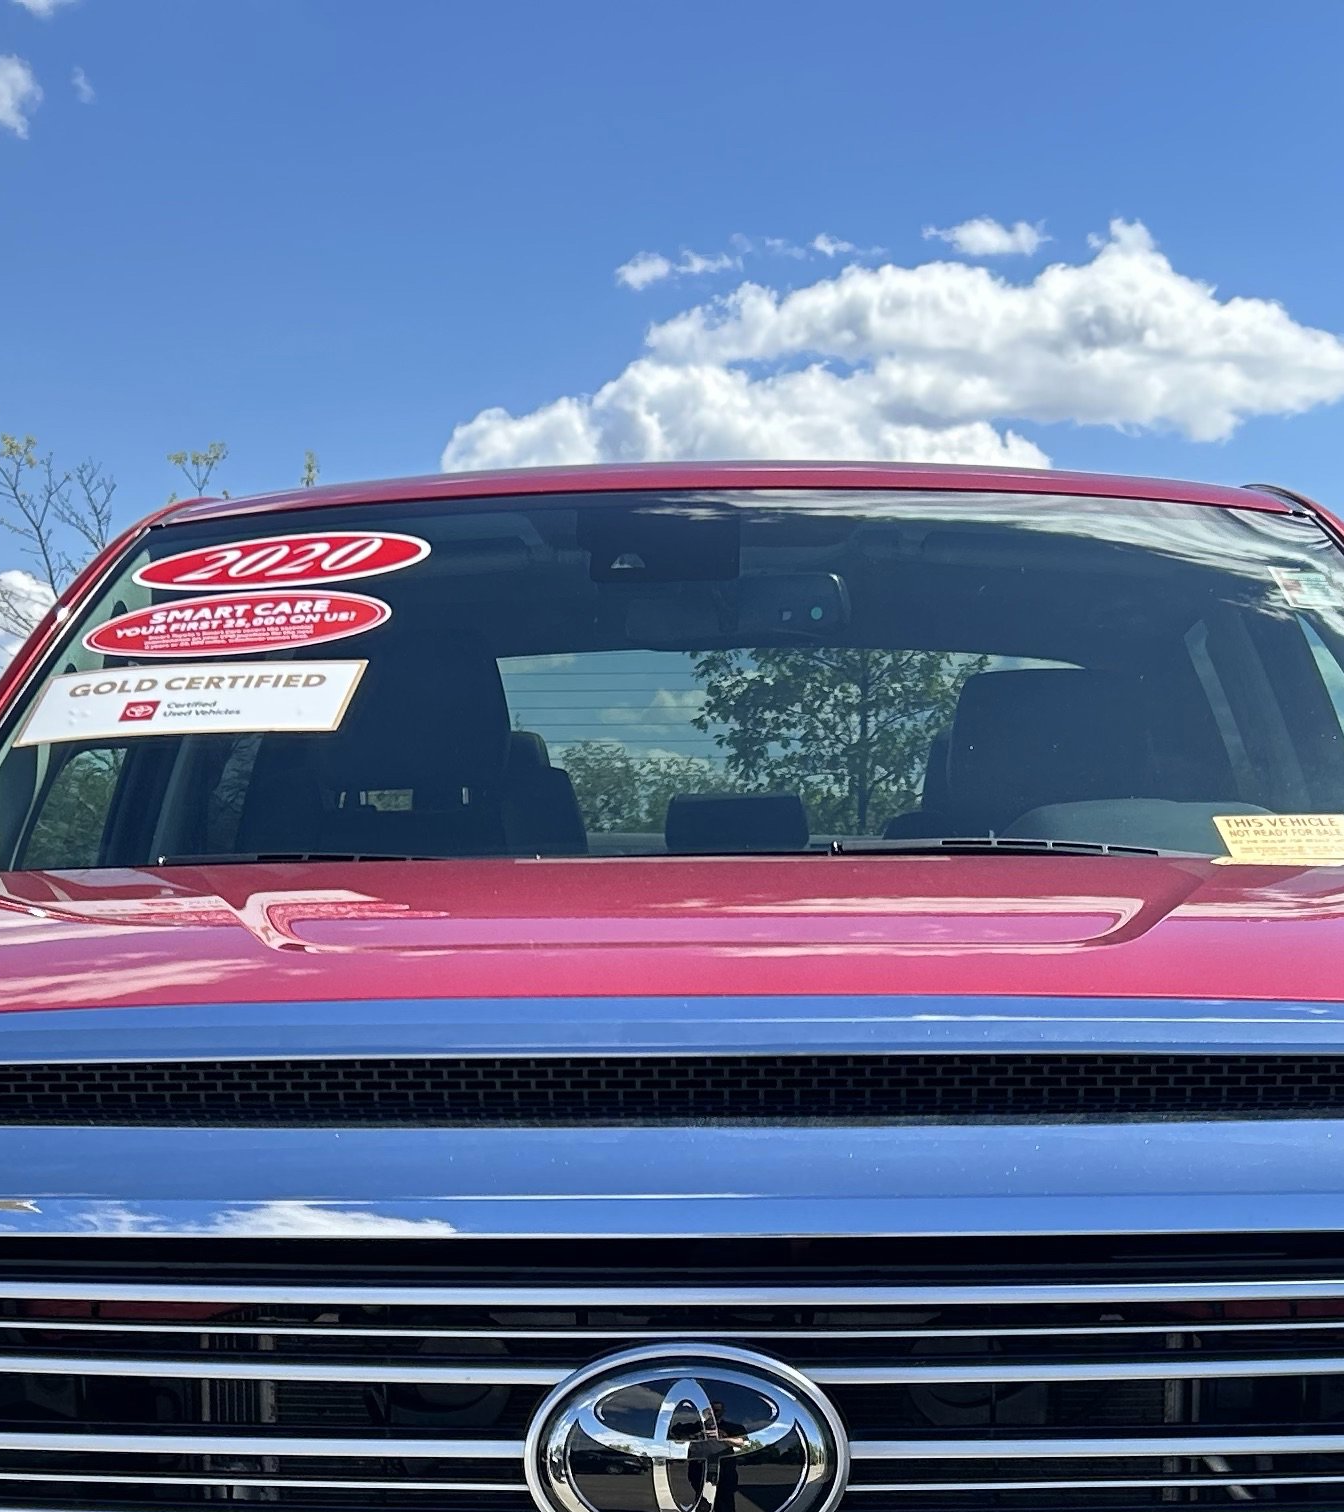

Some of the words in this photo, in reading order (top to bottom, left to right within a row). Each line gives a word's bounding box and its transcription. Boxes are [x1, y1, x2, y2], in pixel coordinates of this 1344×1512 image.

[172, 537, 383, 582] 2020
[149, 604, 251, 625] SMART
[253, 599, 332, 616] CARE
[115, 624, 167, 639] YOUR
[169, 619, 222, 633] FIRST
[289, 613, 321, 624] ON
[323, 611, 356, 623] US!
[69, 678, 159, 698] GOLD
[164, 674, 328, 691] CERTIFIED
[167, 700, 217, 709] Certified
[1224, 818, 1263, 828] THIS
[1266, 817, 1339, 827] VEHICLE
[1229, 829, 1250, 838] NOT
[1253, 829, 1288, 837] READY
[1291, 828, 1312, 837] FOR
